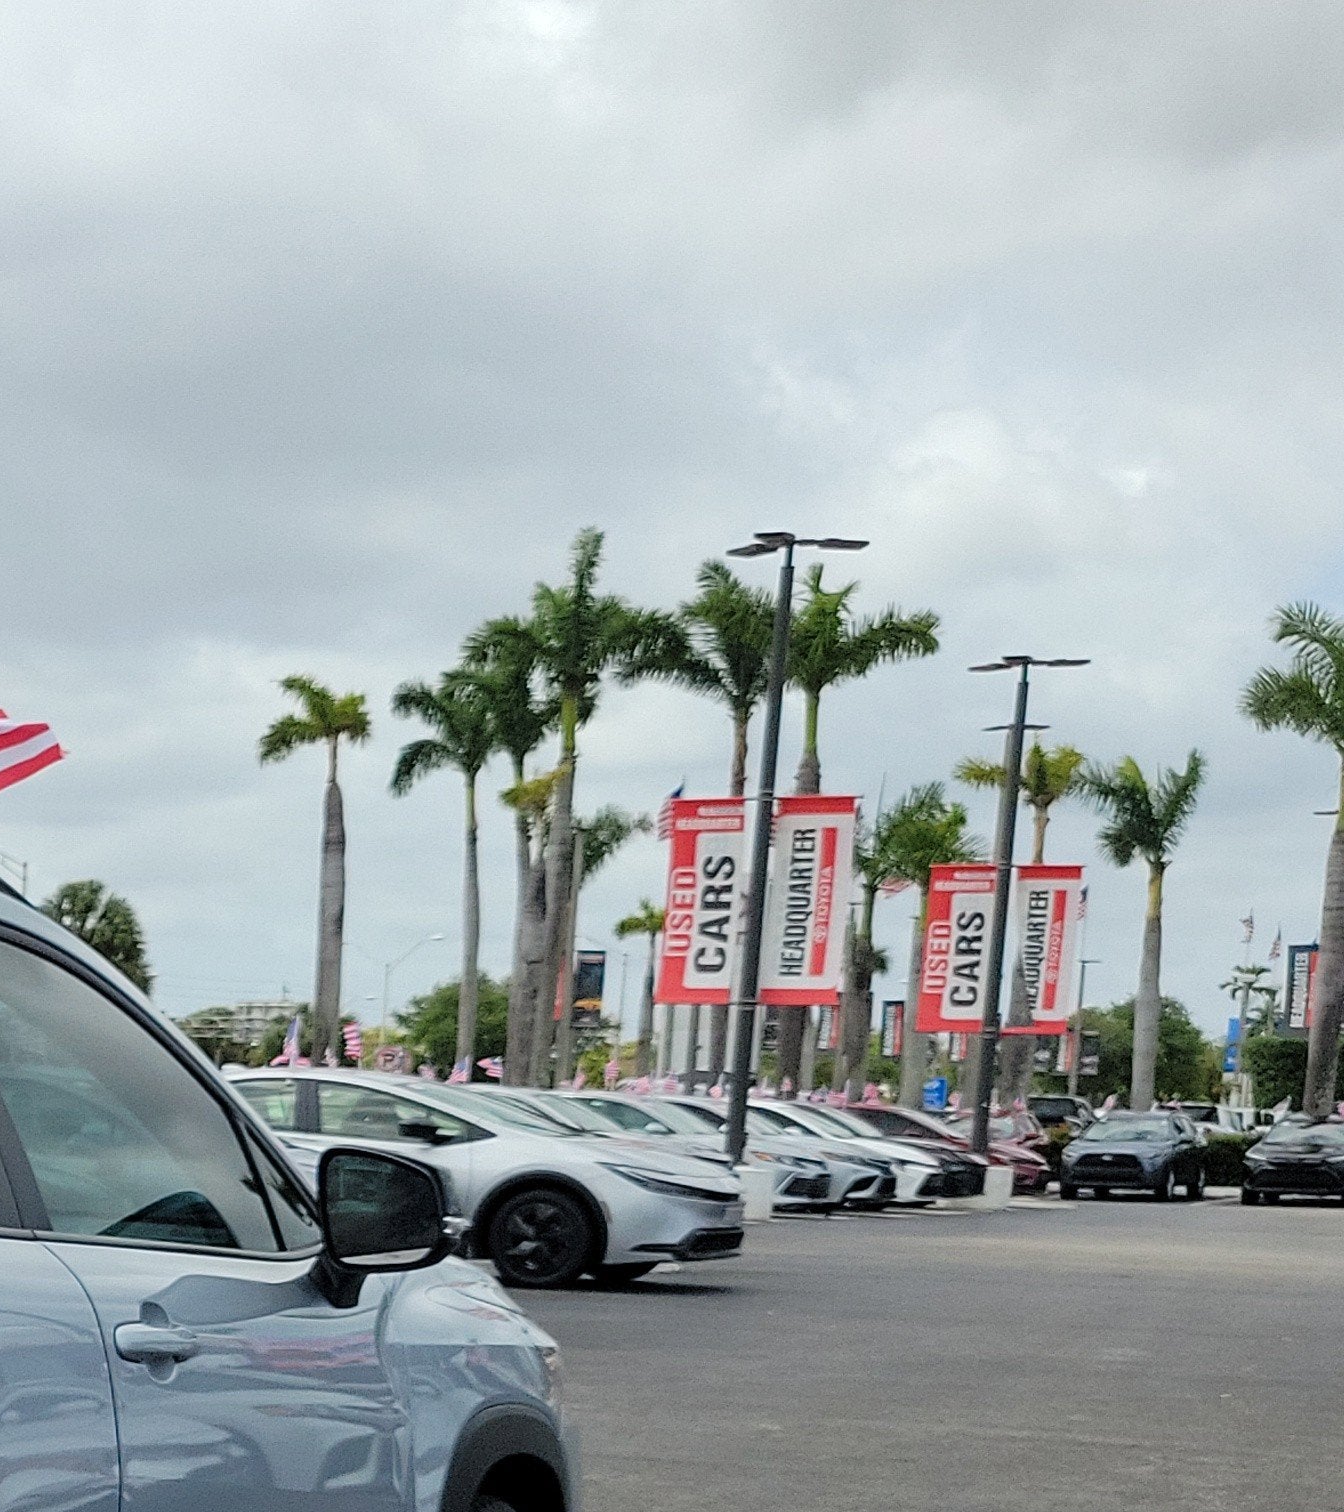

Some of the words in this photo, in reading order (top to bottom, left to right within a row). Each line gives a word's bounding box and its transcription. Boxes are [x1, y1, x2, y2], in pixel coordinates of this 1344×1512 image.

[665, 868, 696, 955] USED
[693, 855, 735, 973] CARS
[779, 829, 817, 976] HEADQUARTER
[817, 866, 833, 924] TOYOTA
[926, 923, 951, 992] USED
[950, 911, 985, 1006] CARS
